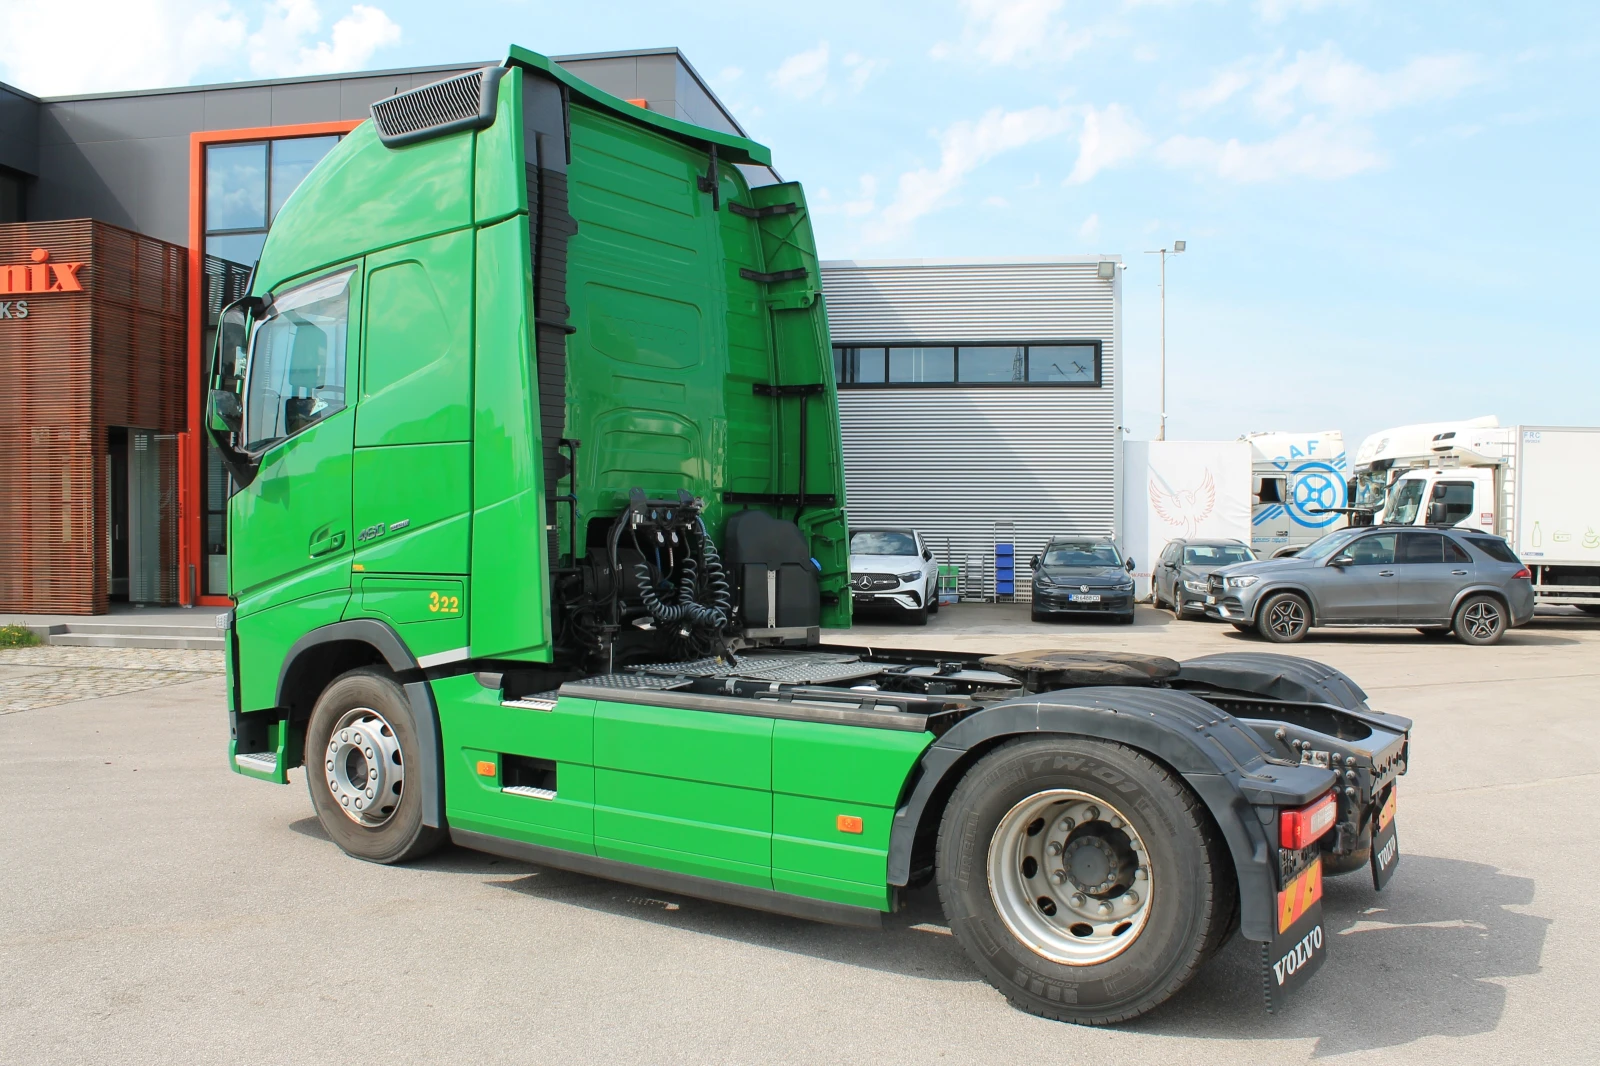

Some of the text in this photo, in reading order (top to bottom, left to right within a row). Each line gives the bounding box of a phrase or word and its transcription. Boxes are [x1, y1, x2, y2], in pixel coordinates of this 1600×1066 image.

[1523, 431, 1541, 439] FRC
[1271, 440, 1319, 471] DAF
[358, 522, 386, 543] 460
[429, 591, 459, 613] 322
[955, 809, 980, 892] PIRELLI
[1377, 834, 1396, 871] VOLVO
[1272, 925, 1322, 986] VOLVO
